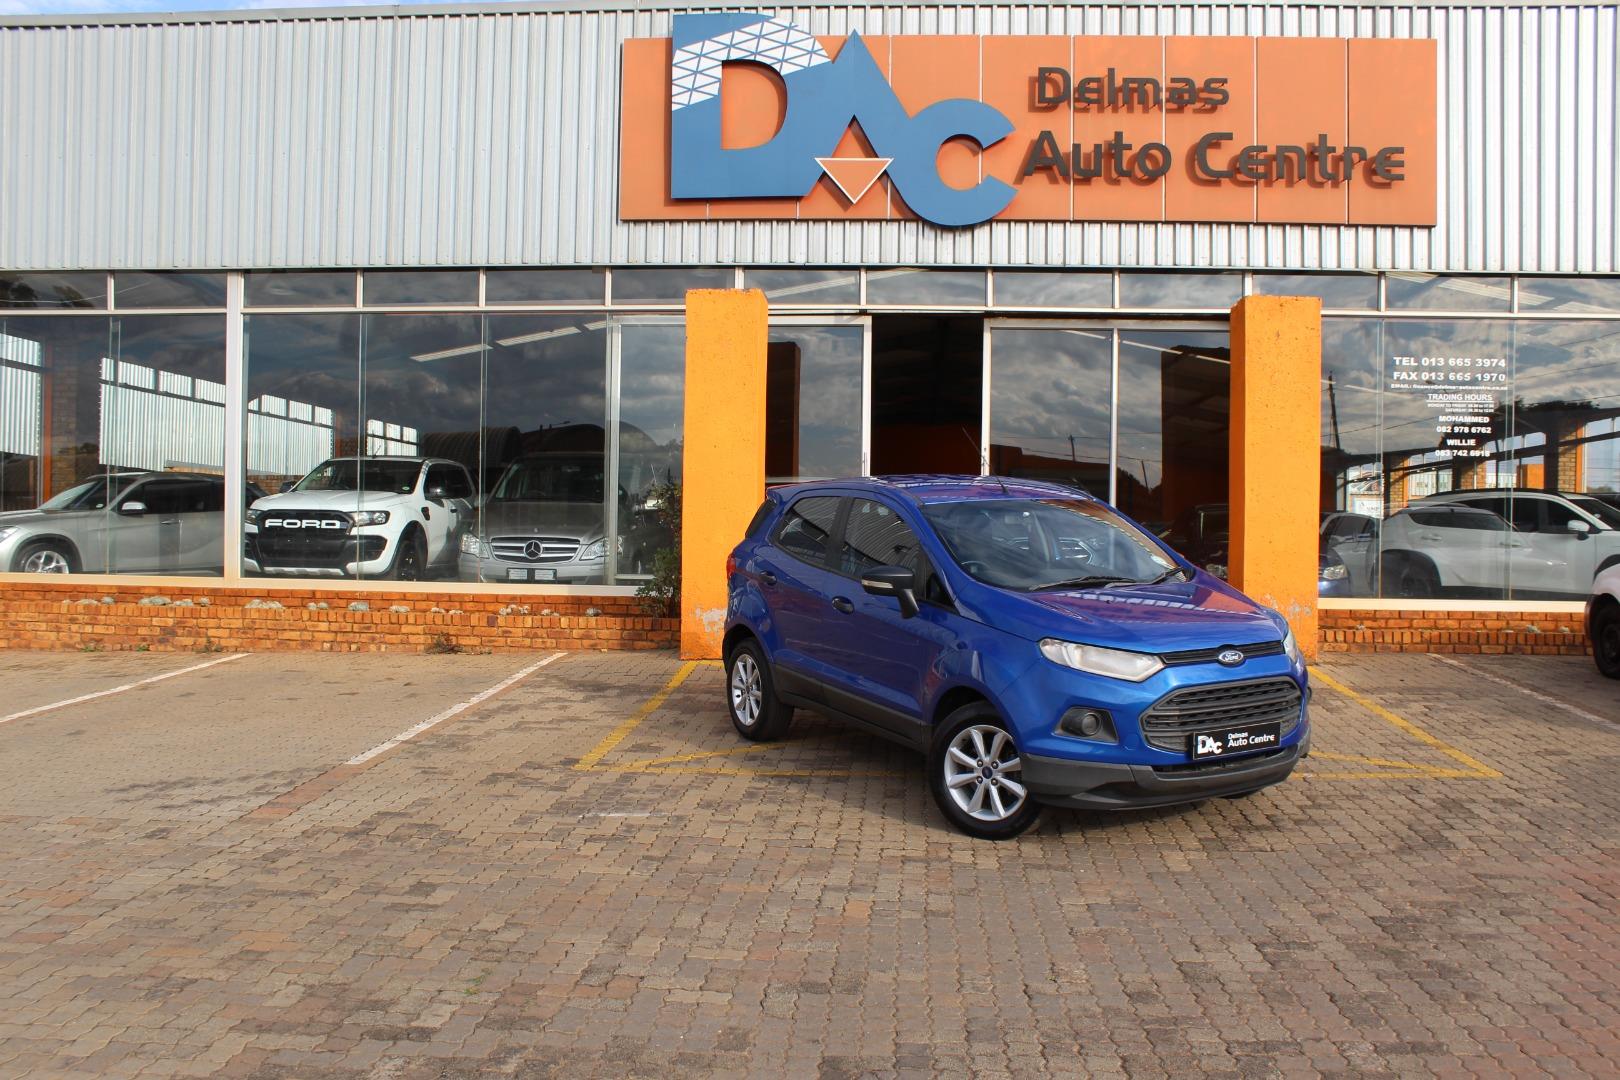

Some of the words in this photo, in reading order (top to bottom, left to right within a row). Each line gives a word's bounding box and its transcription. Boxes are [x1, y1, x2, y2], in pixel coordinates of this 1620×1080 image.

[1037, 66, 1230, 106] Delmas
[1023, 130, 1173, 178] Auto
[1194, 131, 1405, 182] Centre
[1393, 357, 1418, 366] TEL
[1421, 357, 1445, 367] 013
[1448, 358, 1472, 367] 665
[1475, 358, 1506, 368] 3974
[1393, 371, 1418, 380] FAX
[1421, 371, 1445, 381] 013
[1448, 372, 1472, 381] 665
[1475, 373, 1506, 382] 1970
[1427, 393, 1463, 401] TRADING
[1438, 415, 1490, 423] MOHAMMED
[1470, 426, 1492, 434] 6762
[1446, 438, 1476, 446] WILLIE
[1452, 449, 1468, 457] 742
[264, 518, 341, 529] FORD
[1224, 651, 1240, 661] Ford
[1227, 737, 1248, 748] Auto
[1248, 733, 1276, 744] Centre
